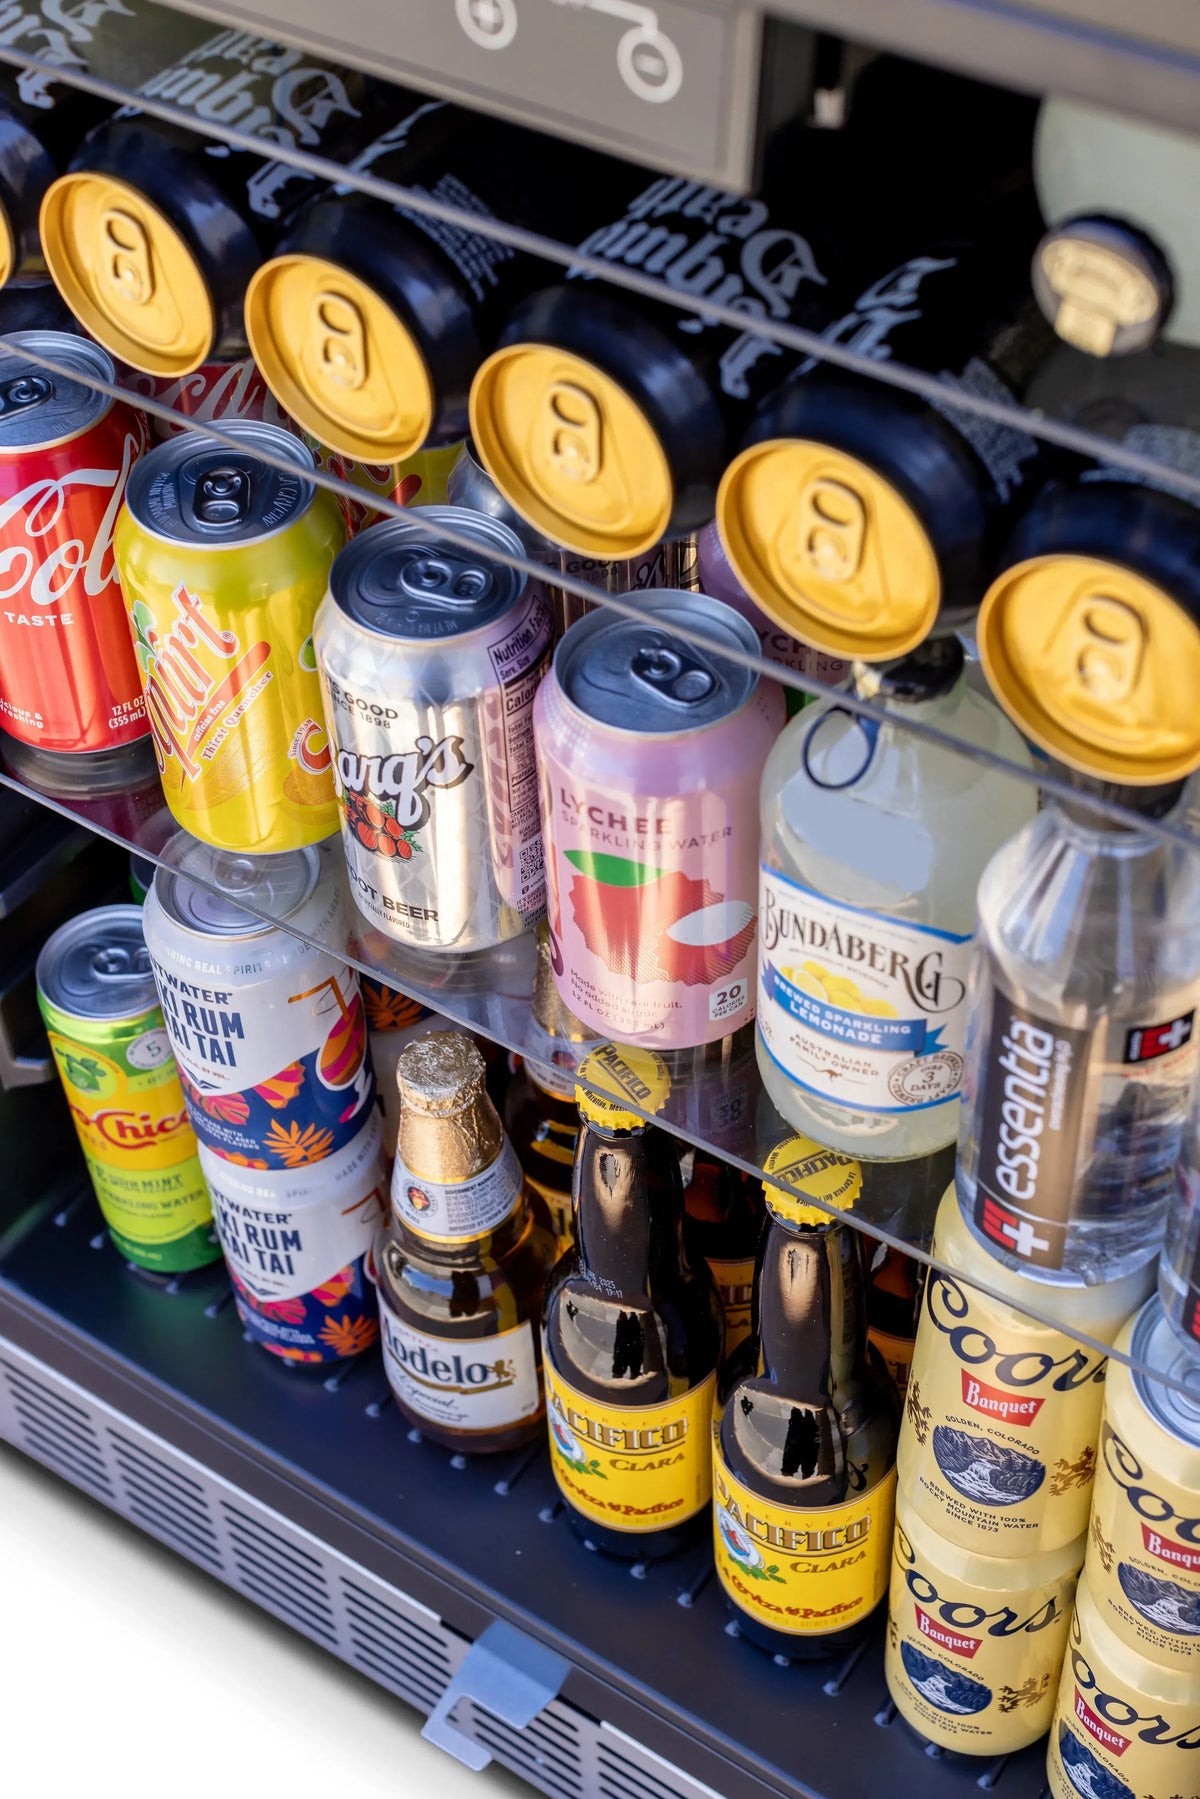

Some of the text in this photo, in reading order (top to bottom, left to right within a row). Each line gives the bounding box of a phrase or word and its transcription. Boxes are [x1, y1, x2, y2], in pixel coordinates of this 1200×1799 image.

[4, 611, 74, 627] TASTE
[492, 628, 533, 665] Nutrition
[146, 580, 239, 782] quirt
[112, 706, 123, 717] 12
[122, 703, 133, 713] FL
[344, 691, 398, 719] GOOD
[360, 711, 391, 729] 1898
[202, 727, 229, 761] Thirst
[336, 735, 475, 828] arq's
[560, 787, 672, 835] LYCHEE
[668, 826, 732, 850] WATER
[347, 862, 439, 921] OOT BEER
[760, 886, 966, 1014] BUNDABERG
[570, 968, 596, 992] Made
[652, 1000, 683, 1009] fruit.
[571, 978, 584, 992] No
[585, 990, 620, 1010] added
[583, 999, 594, 1010] FL
[712, 995, 745, 1013] CALORIES
[717, 984, 741, 1006] 20
[774, 974, 911, 1035] BREWED SPARKLING
[181, 999, 245, 1039] RUM
[714, 1001, 744, 1019] PER CAN
[790, 1001, 882, 1044] LEMONADE
[146, 1041, 161, 1058] 5
[192, 1030, 237, 1067] TAI
[789, 1036, 879, 1076] FAMILY OWNED
[794, 1033, 872, 1068] AUSTRALIAN
[922, 1071, 935, 1084] 3
[996, 1020, 1055, 1199] essentia
[244, 1223, 303, 1252] RUM
[255, 1250, 295, 1276] TAI
[548, 1380, 688, 1450] ACIFICO
[965, 1380, 1037, 1418] Banquet
[944, 1414, 1040, 1456] GOLDEN, COLORADO
[609, 1452, 685, 1473] CLARA
[919, 1476, 1040, 1531] ROCKY MOUNTAIN WATER
[929, 1481, 1026, 1525] BREWED WITH 100%
[945, 1508, 1000, 1534] SINCE 1873
[789, 1551, 867, 1574] CLARA
[919, 1613, 977, 1650] Banquet
[1108, 1598, 1192, 1652] ROCKY MOUNTAIN
[1118, 1605, 1189, 1647] BREWED WITH
[1136, 1631, 1193, 1656] SINCE 1873
[938, 1653, 985, 1682] COLORADO
[961, 1727, 993, 1735] WATER
[1076, 1696, 1126, 1749] Banquet
[1088, 1742, 1130, 1783] COLORADO
